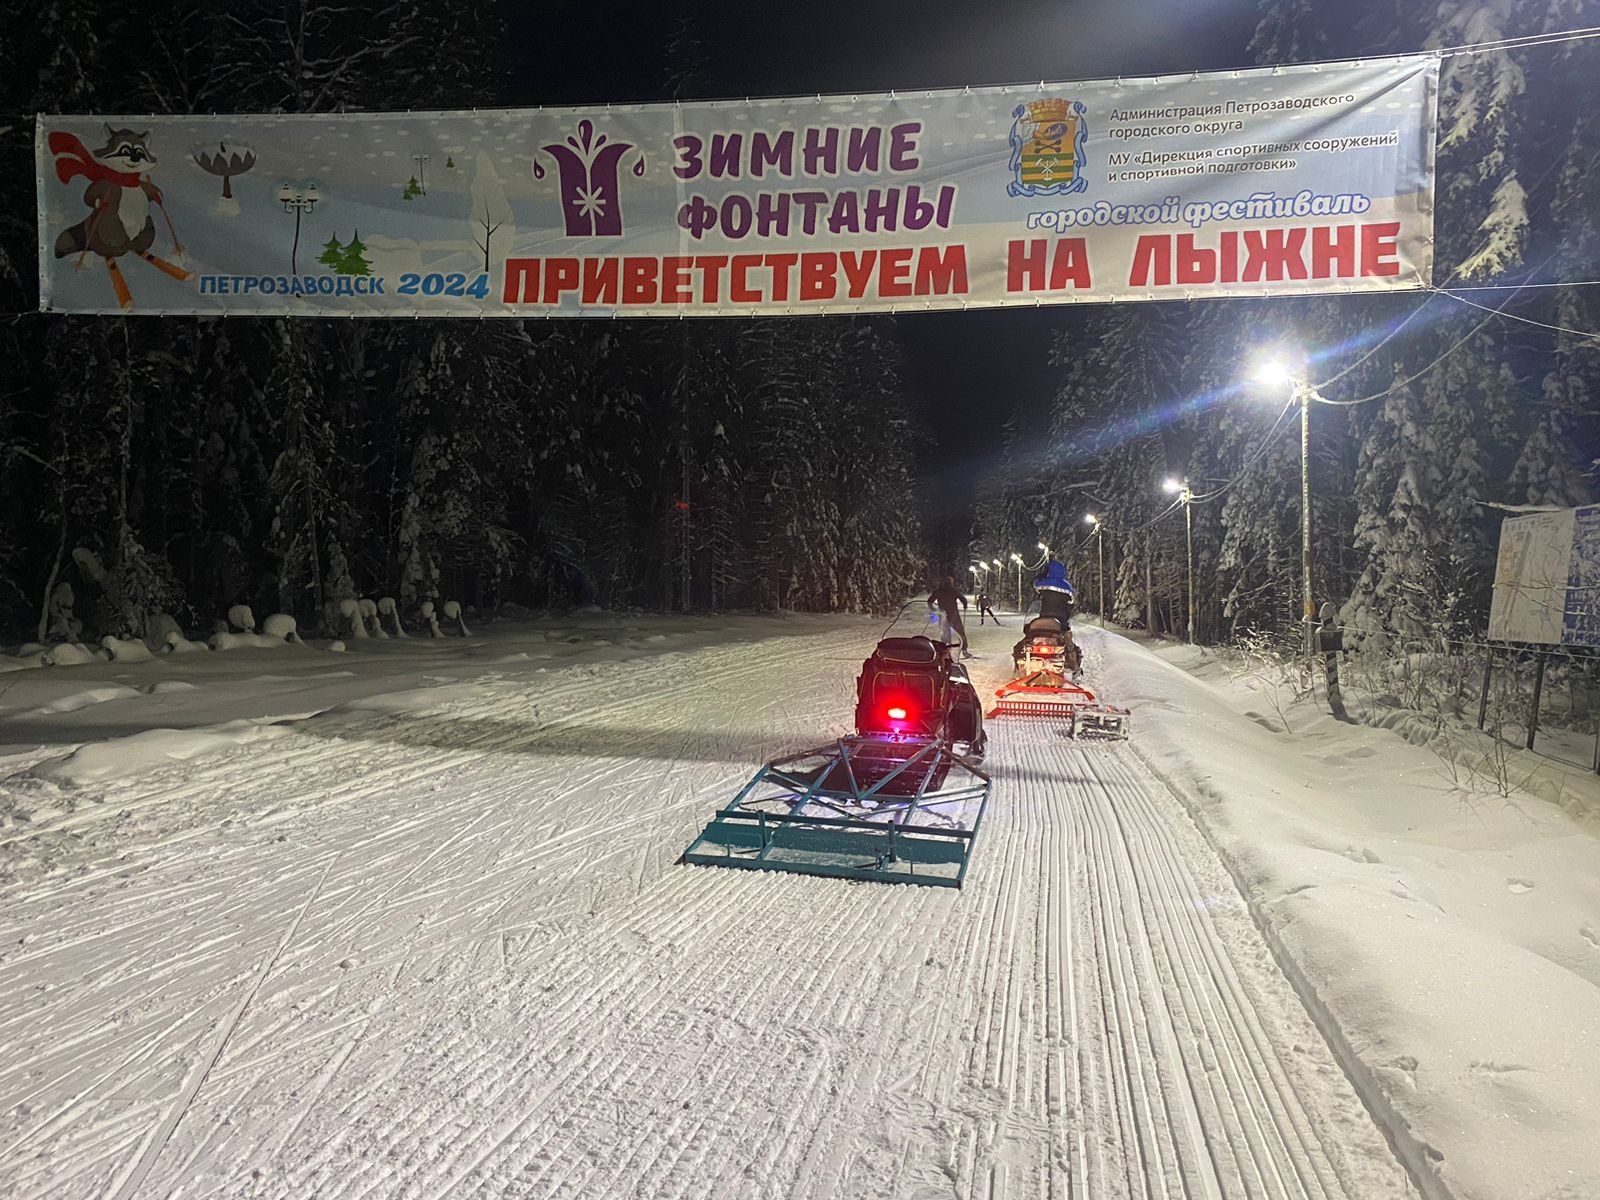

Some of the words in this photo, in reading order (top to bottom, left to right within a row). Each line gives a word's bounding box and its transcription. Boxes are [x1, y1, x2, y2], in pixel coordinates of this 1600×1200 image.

[1109, 103, 1222, 122] Администрация
[1225, 94, 1355, 115] Петрозаводского
[1109, 123, 1191, 141] городского
[1193, 120, 1243, 136] округа
[673, 122, 922, 178] ЗИМНИЕ
[1108, 153, 1132, 167] МУ
[1133, 149, 1213, 166] «Дирекция
[1216, 141, 1301, 160] спортивных
[1303, 131, 1399, 152] сооружений
[1108, 172, 1117, 182] и
[1120, 163, 1205, 183] спортивной
[1208, 160, 1296, 177] подготовки»
[677, 185, 957, 239] ФОНТАНЫ
[1027, 196, 1181, 233] городской
[1184, 190, 1369, 228] фестиваль
[503, 244, 969, 303] ПРИВЕТСТВУЕМ
[1007, 238, 1092, 293] НА
[1128, 221, 1402, 288] ЛЫЖНЕ
[199, 276, 385, 297] ПЕТРОЗАВОДСК
[397, 273, 489, 299] 2024
